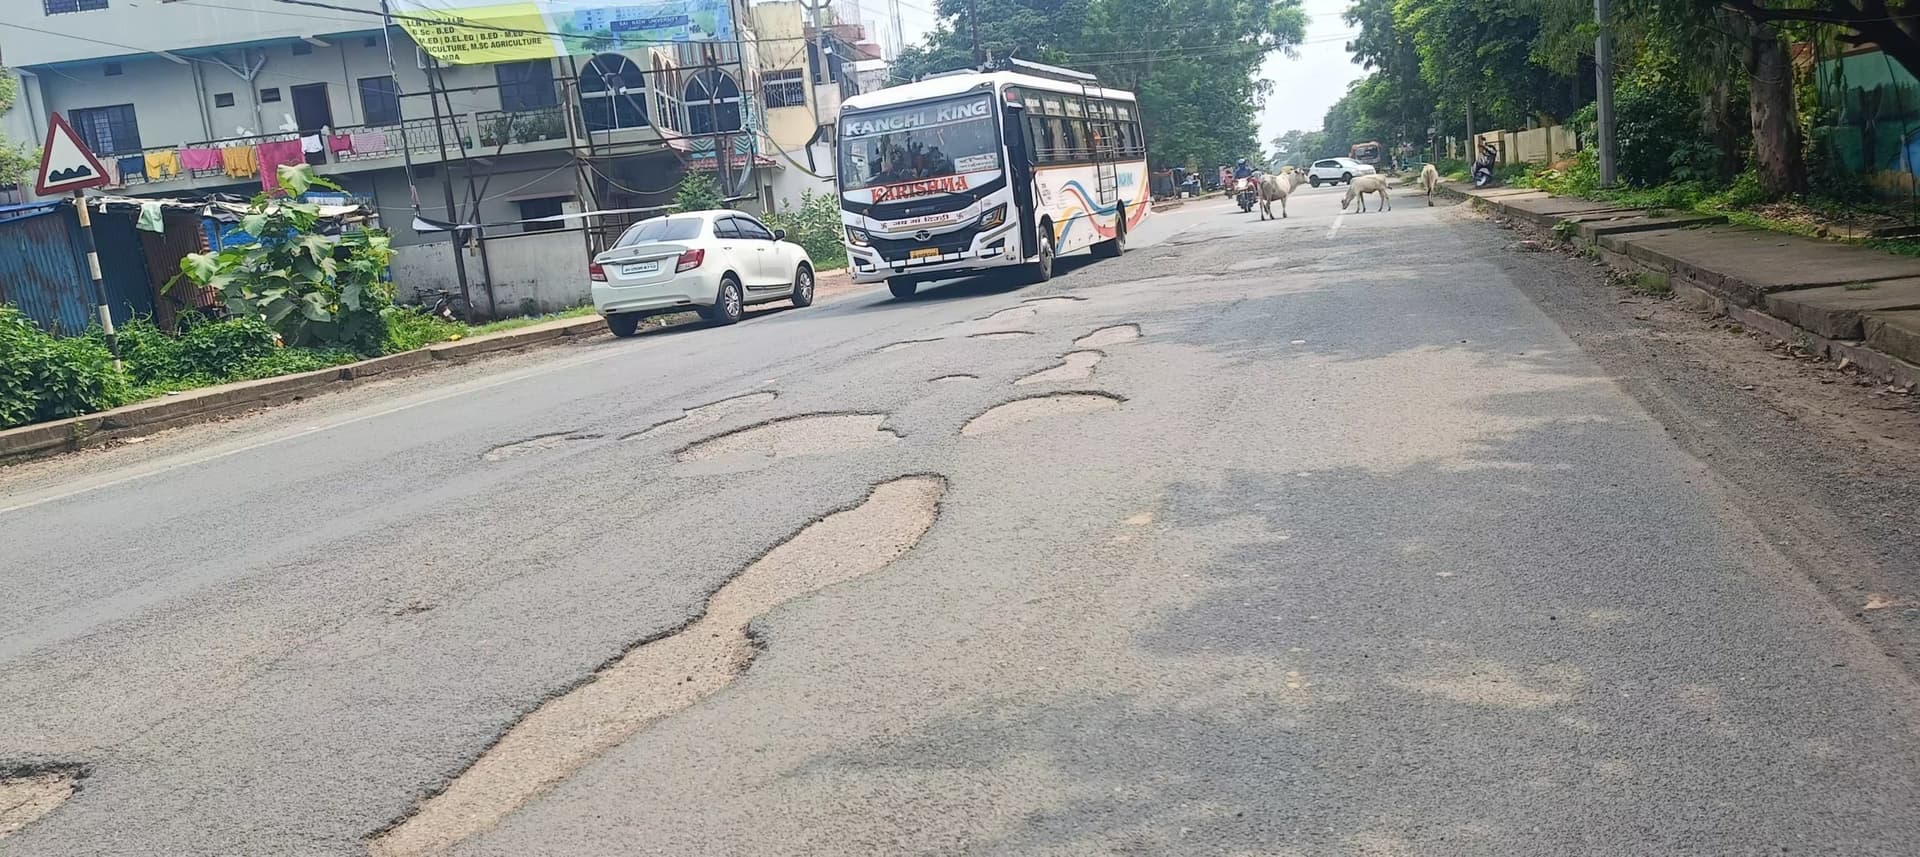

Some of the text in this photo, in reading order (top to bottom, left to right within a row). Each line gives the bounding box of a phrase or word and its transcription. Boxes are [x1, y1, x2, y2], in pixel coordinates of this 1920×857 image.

[490, 37, 542, 48] AGRICULTURE
[846, 100, 987, 136] KANCHI KING
[871, 175, 969, 204] KARISHMA
